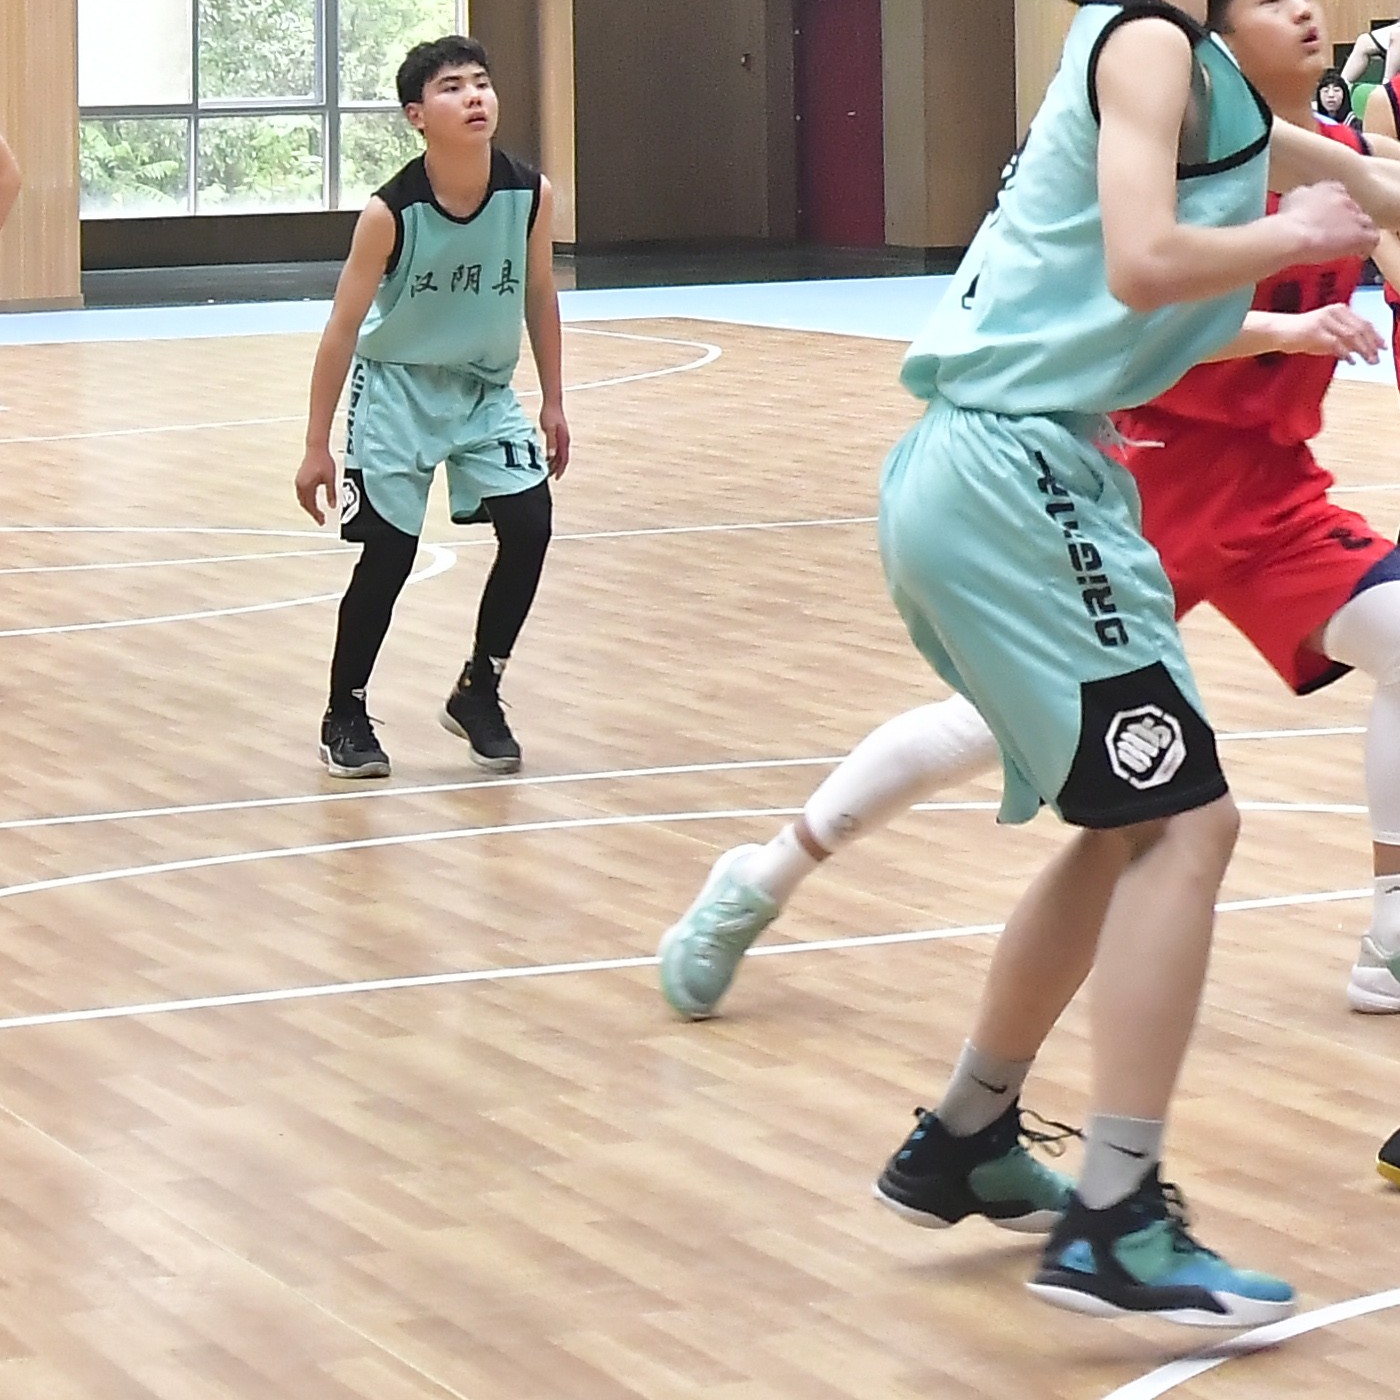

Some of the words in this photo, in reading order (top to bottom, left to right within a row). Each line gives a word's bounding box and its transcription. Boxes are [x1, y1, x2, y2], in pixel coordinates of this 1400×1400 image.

[410, 258, 520, 298] 汉阴县
[497, 439, 544, 474] 11
